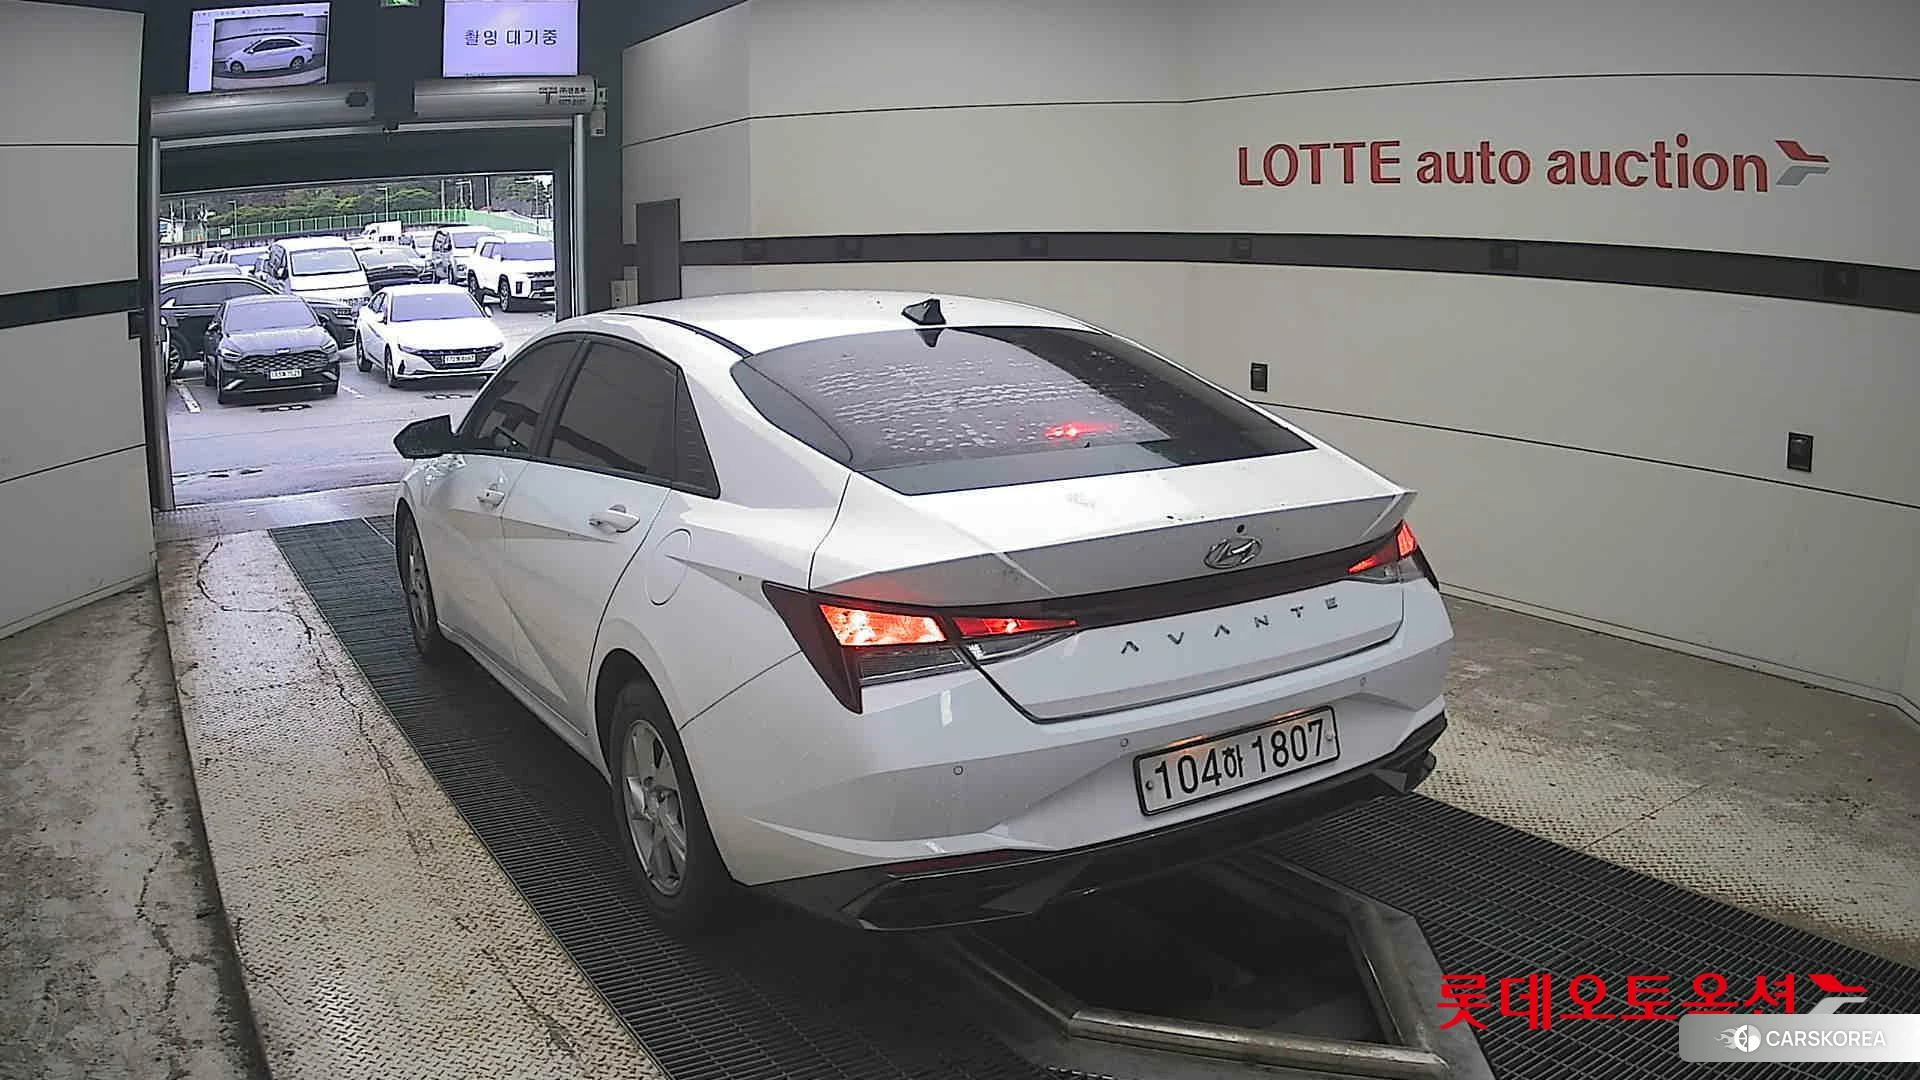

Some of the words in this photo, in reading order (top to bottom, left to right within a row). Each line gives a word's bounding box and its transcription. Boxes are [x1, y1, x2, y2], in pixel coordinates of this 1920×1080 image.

[506, 29, 558, 46] 대기중
[1238, 140, 1400, 187] LOTTE
[1416, 141, 1531, 184] auto
[1547, 133, 1768, 192] auction
[1121, 597, 1339, 654] AVANTE
[1154, 744, 1244, 799] 104하
[1251, 718, 1324, 773] 1807
